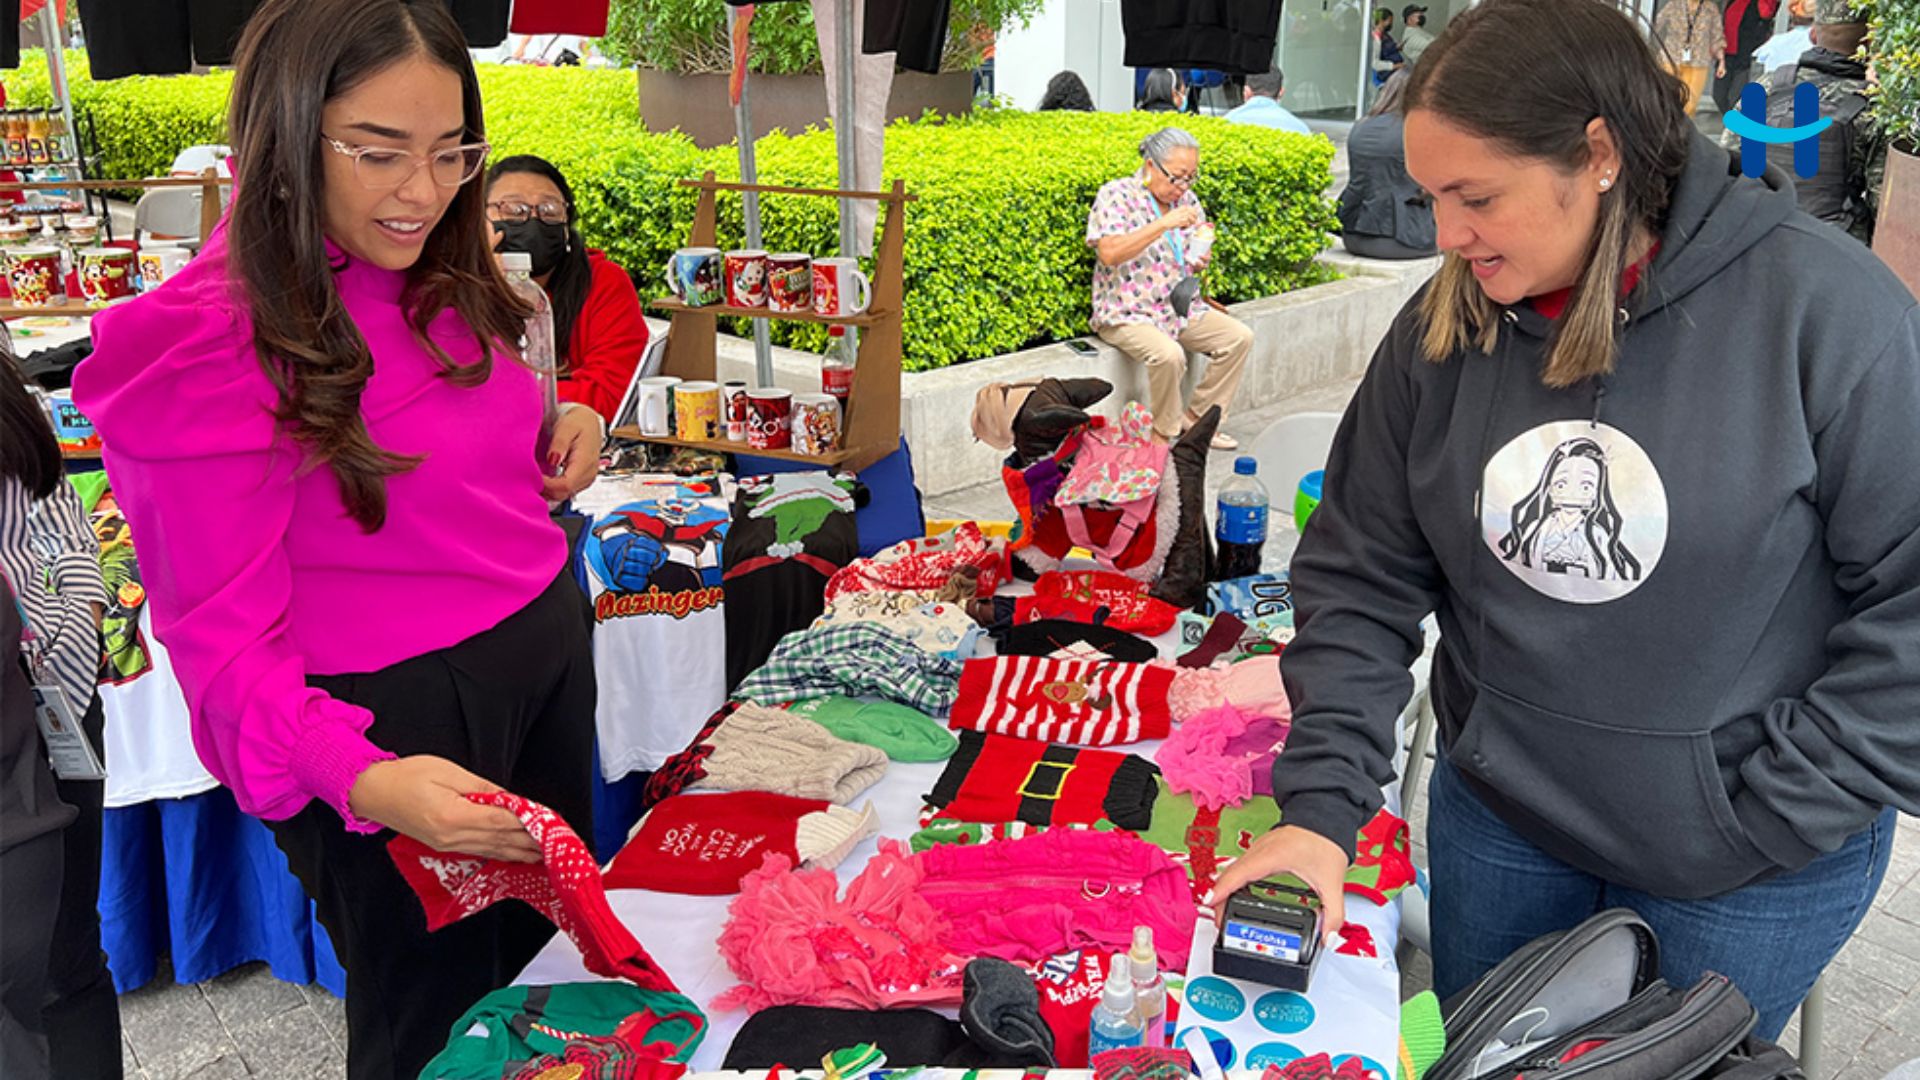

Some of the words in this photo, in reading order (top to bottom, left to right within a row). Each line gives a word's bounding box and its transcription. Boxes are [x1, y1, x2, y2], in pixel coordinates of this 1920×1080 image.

[596, 584, 724, 621] Mazinger
[659, 828, 679, 852] ON
[699, 828, 726, 861] CALM
